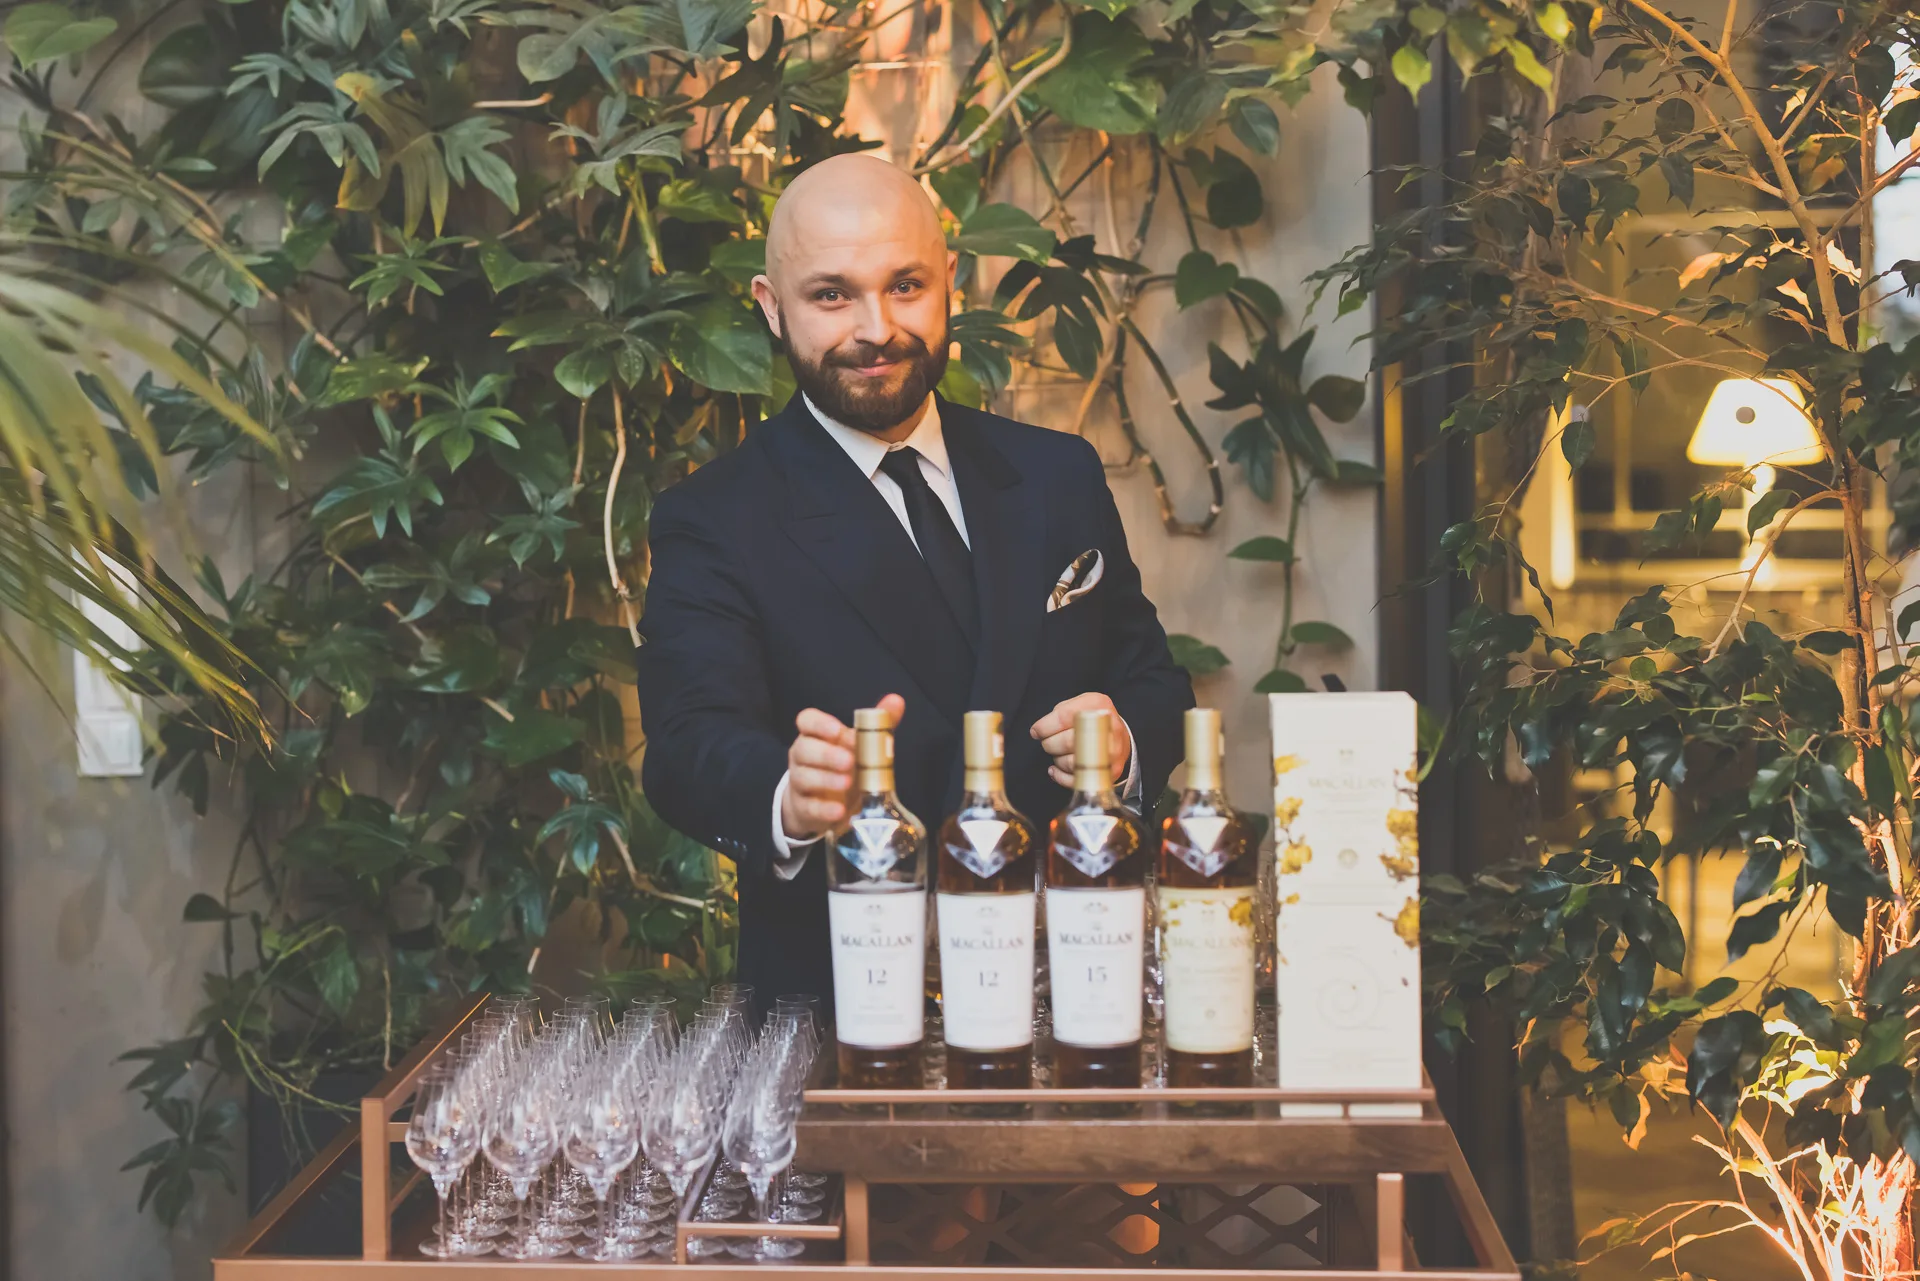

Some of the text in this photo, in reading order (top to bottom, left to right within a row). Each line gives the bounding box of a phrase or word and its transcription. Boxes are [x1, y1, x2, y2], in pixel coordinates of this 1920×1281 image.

[840, 933, 914, 947] MACALLAN
[950, 936, 1025, 950] MACALLAN
[1059, 931, 1134, 945] MACALLAN
[867, 968, 888, 985] 12
[978, 970, 999, 987] 12
[1087, 965, 1108, 983] 15
